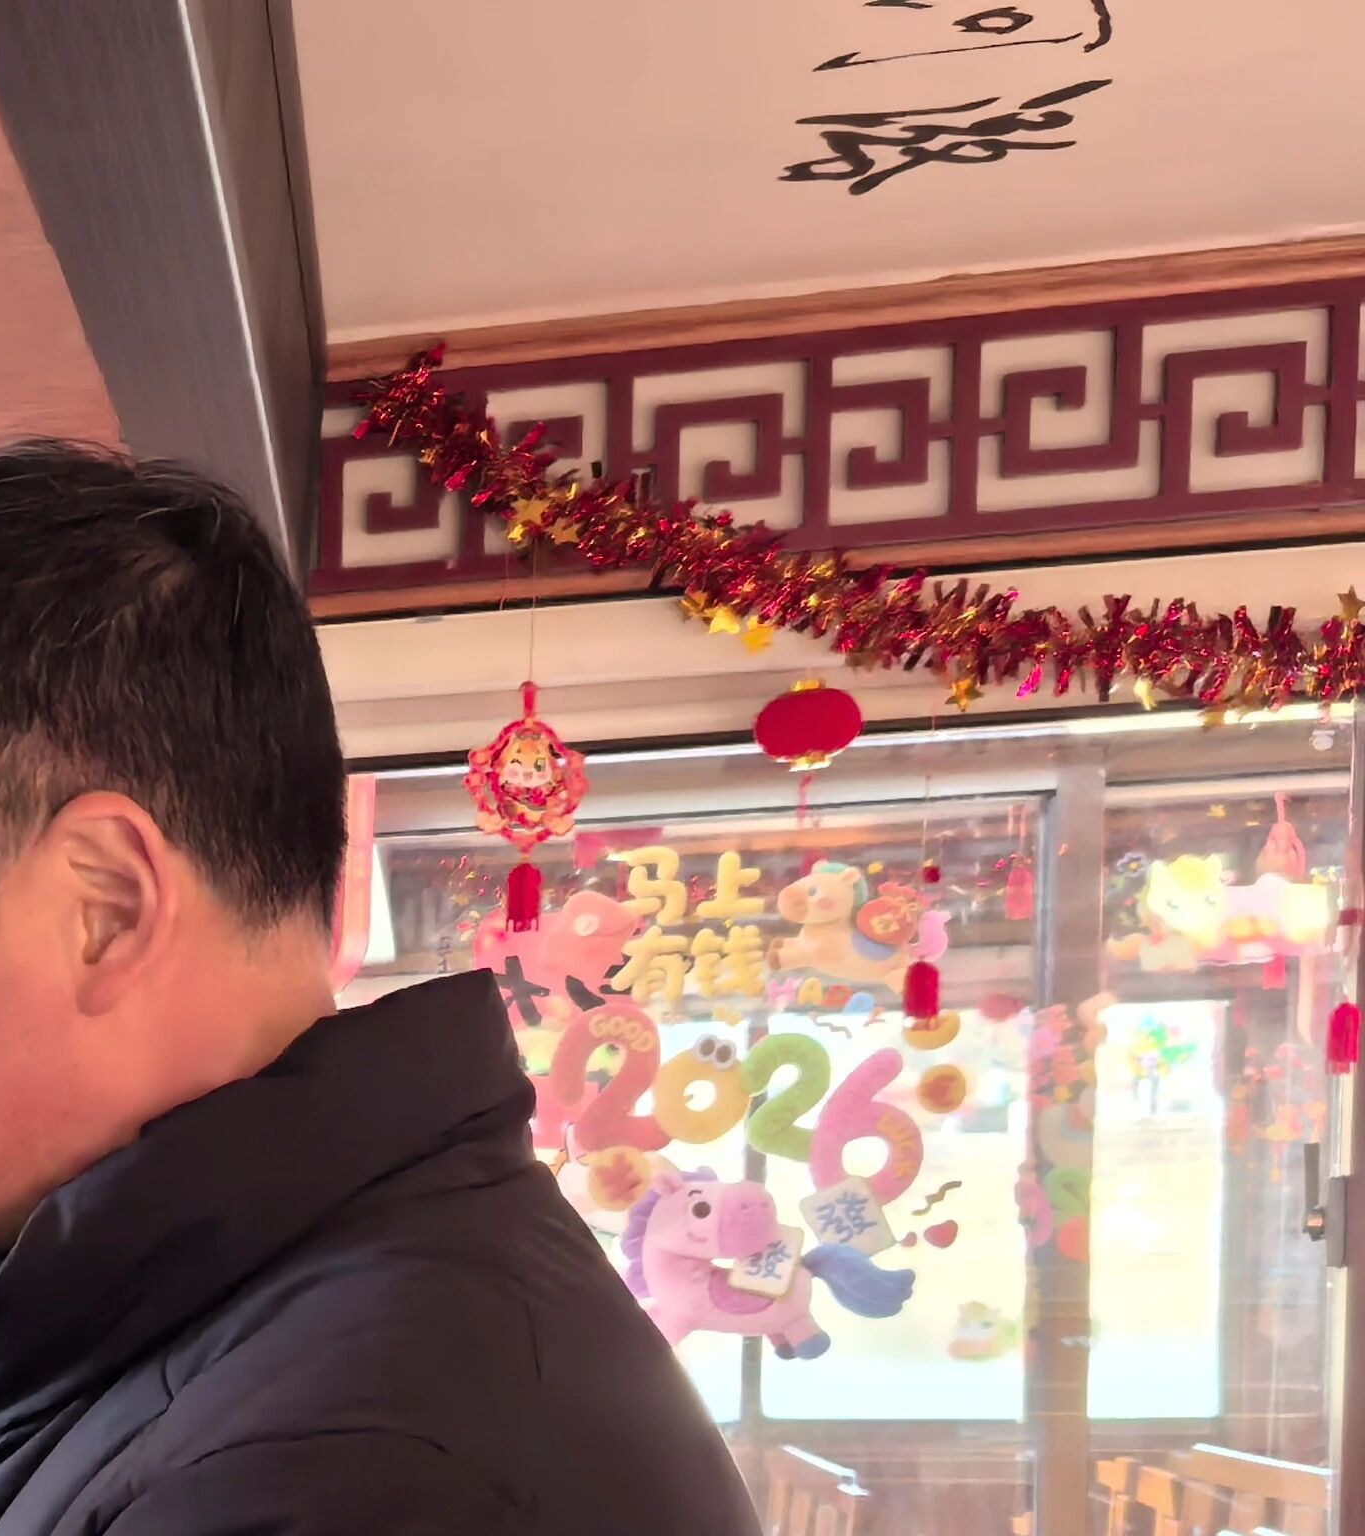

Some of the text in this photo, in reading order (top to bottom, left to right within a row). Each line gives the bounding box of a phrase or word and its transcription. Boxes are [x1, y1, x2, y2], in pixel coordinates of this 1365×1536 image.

[606, 846, 765, 926] 马上
[610, 925, 765, 1001] 有钱
[589, 1013, 657, 1053] GOOD
[550, 1003, 923, 1206] 2026
